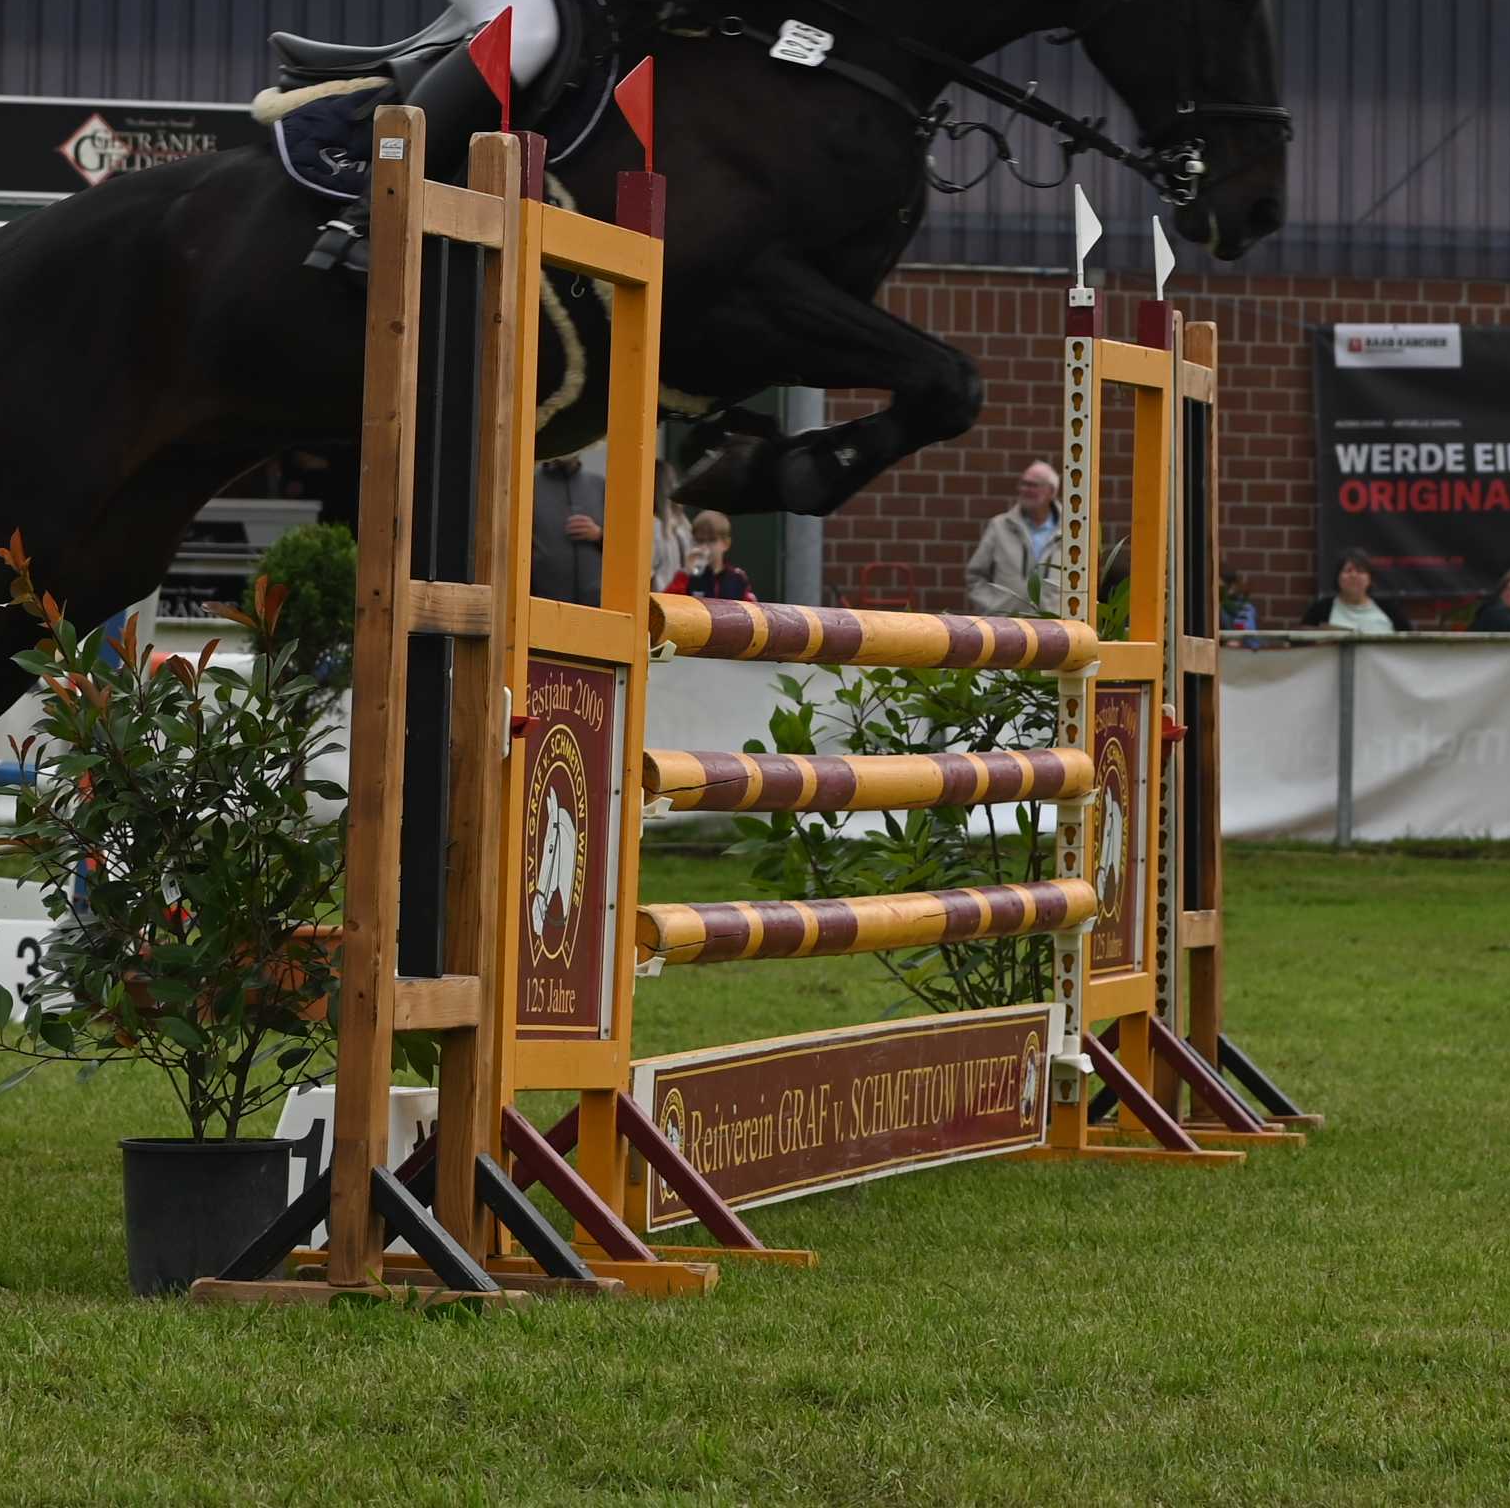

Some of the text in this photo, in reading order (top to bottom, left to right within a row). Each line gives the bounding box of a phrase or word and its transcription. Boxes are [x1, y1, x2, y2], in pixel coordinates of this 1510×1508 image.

[1335, 443, 1466, 473] WERDE
[574, 678, 604, 732] 2009
[551, 734, 586, 819] SCHMETTOW
[572, 831, 586, 908] WEEZE
[16, 937, 42, 1005] 3
[525, 978, 577, 1014] 125 Jahre
[691, 1097, 774, 1175] Reitverein
[778, 1085, 830, 1155] GRAF
[833, 1100, 845, 1143] v.
[850, 1062, 960, 1140] SCHMETTOW
[963, 1054, 1018, 1116] WEEZE
